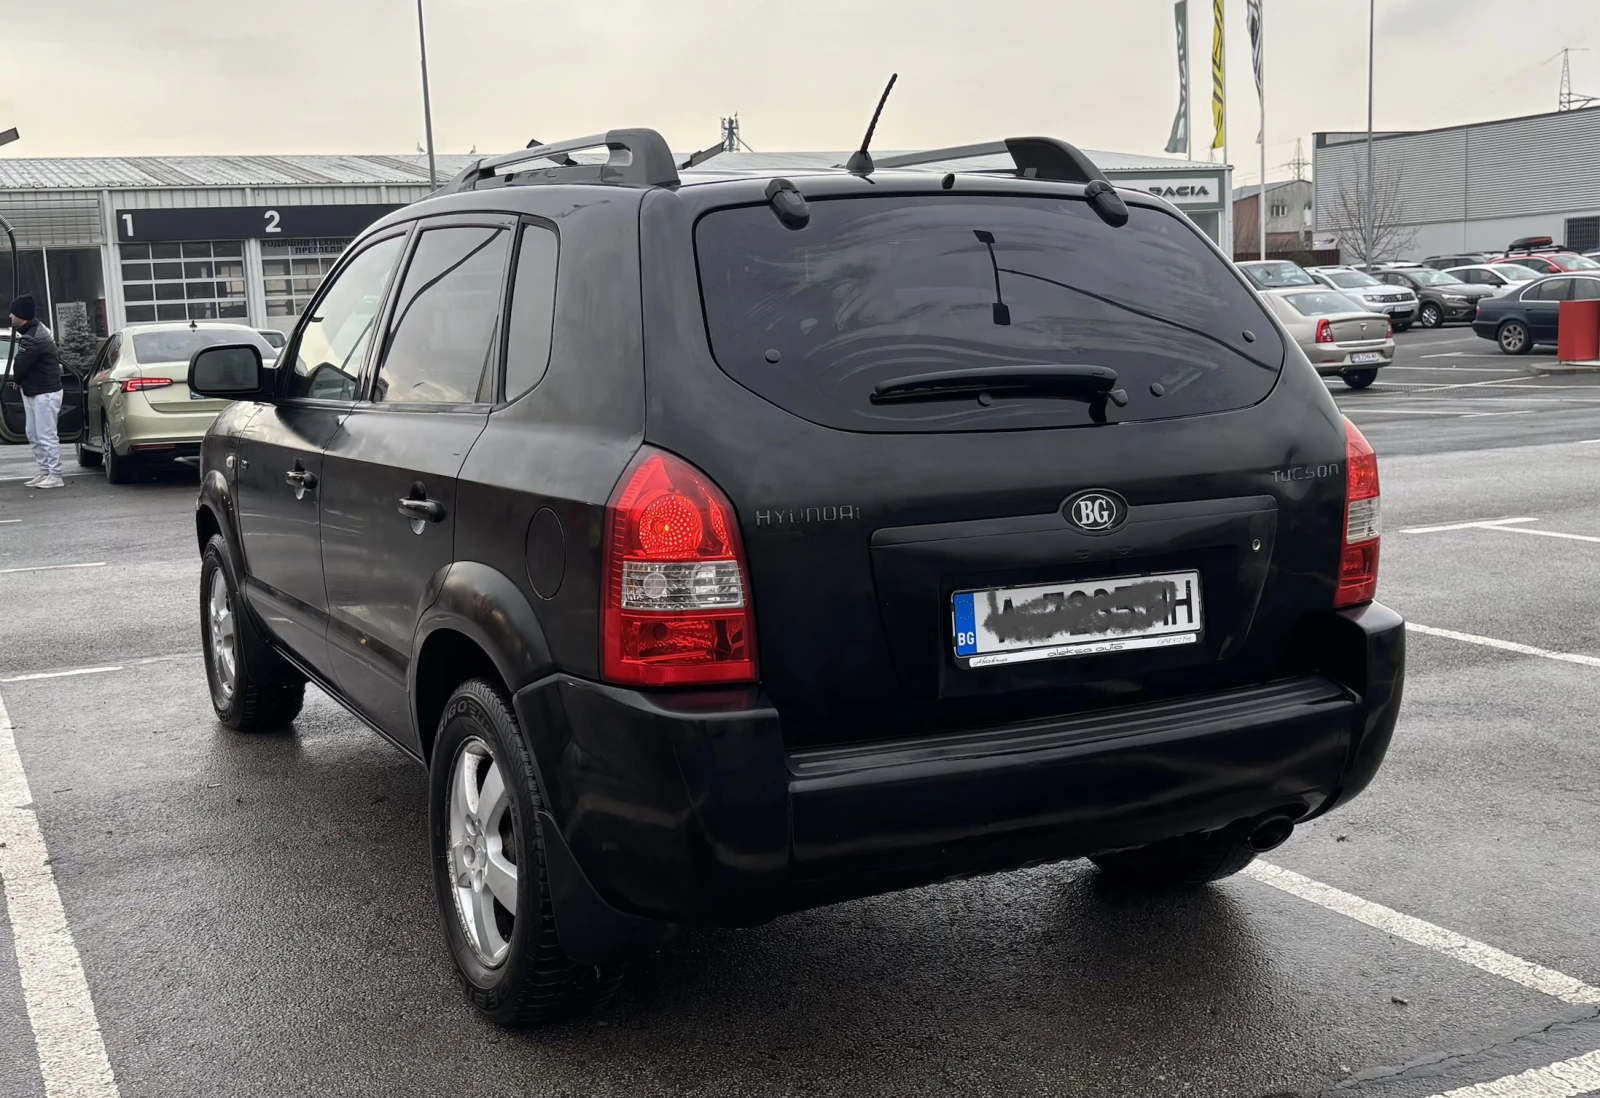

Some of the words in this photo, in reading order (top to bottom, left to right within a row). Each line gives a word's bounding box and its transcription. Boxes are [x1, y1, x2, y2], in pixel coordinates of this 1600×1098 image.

[1149, 186, 1210, 196] DACIA
[122, 213, 134, 237] 1
[263, 210, 282, 233] 2
[262, 239, 310, 248] ГОДИШНИ
[313, 237, 351, 247] ТЕХНИЧ
[295, 246, 343, 254] ПРЕГЛЕДИ
[1271, 463, 1339, 482] TUCSON
[756, 505, 860, 526] HYUNDAI
[1079, 499, 1109, 525] BG
[957, 632, 975, 647] BG
[1047, 645, 1093, 658] aleksa
[1095, 642, 1126, 652] auto
